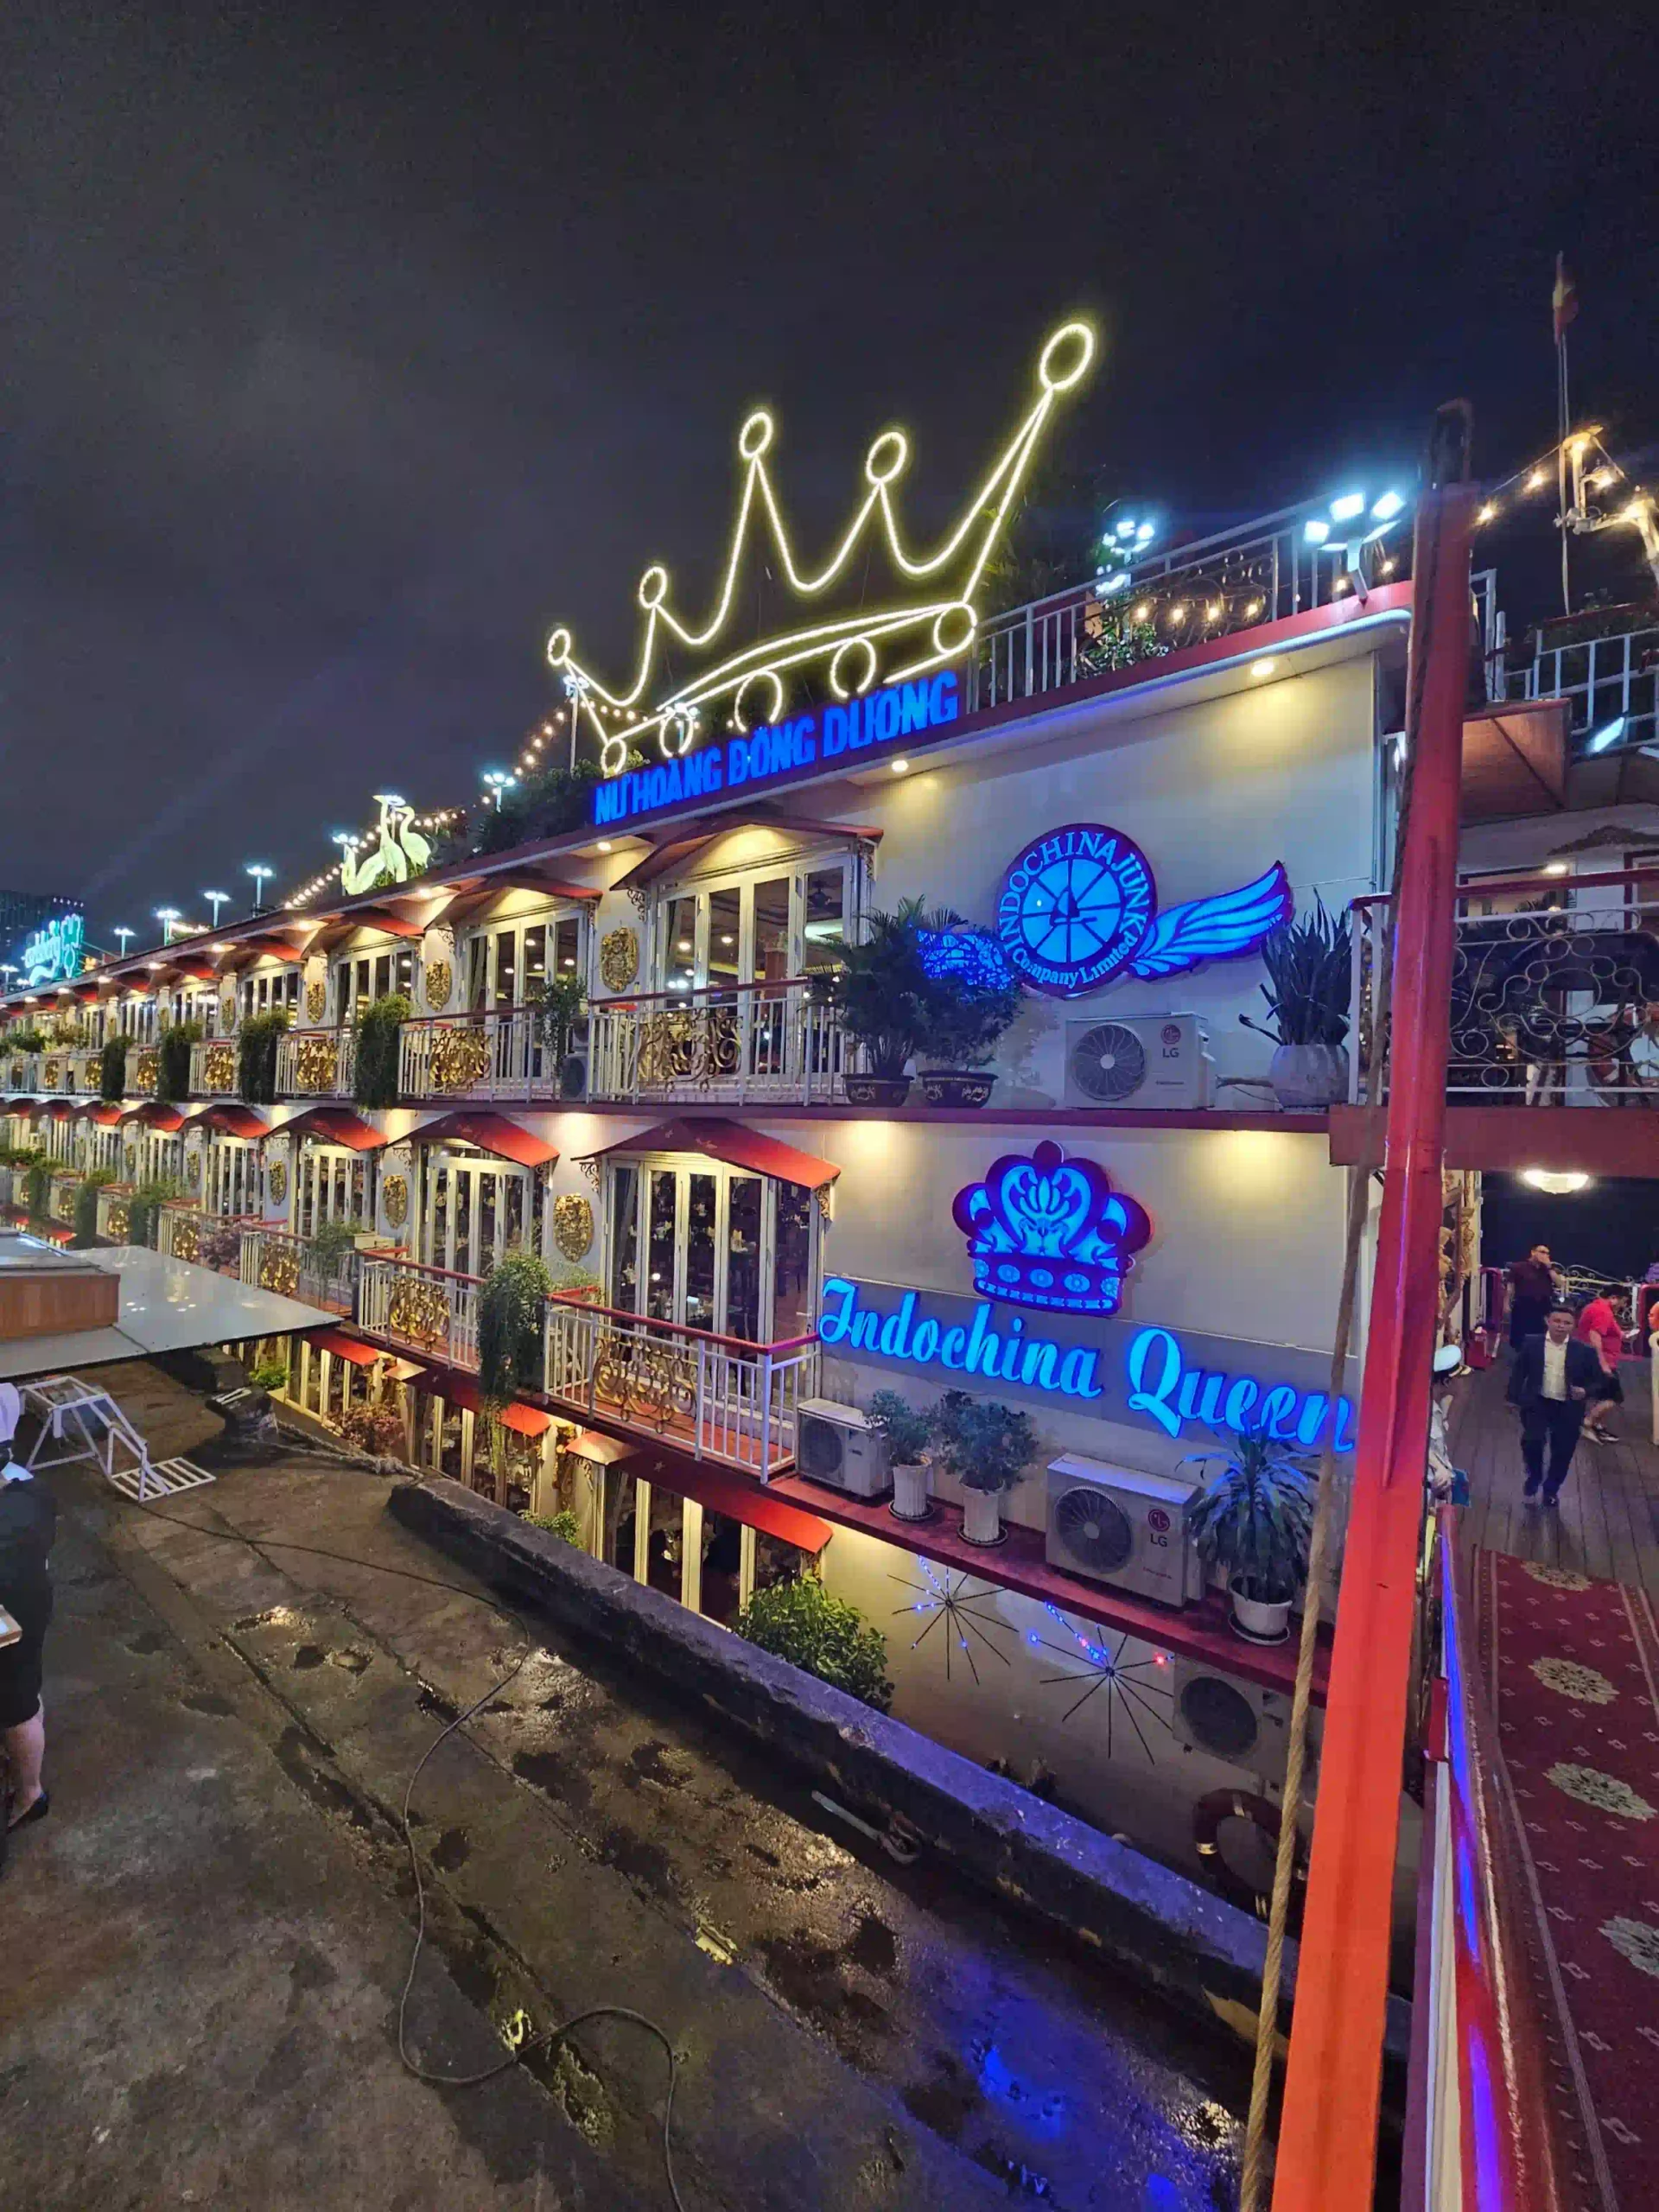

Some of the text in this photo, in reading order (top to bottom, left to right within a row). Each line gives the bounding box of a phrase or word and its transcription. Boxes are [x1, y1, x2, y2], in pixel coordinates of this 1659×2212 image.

[999, 831, 1150, 953] INDOCHINA JUNK
[1013, 931, 1138, 989] Company Limited
[1162, 1047, 1179, 1058] LG
[818, 1277, 1354, 1453] Indochina Queen
[1150, 1533, 1168, 1548] LG
